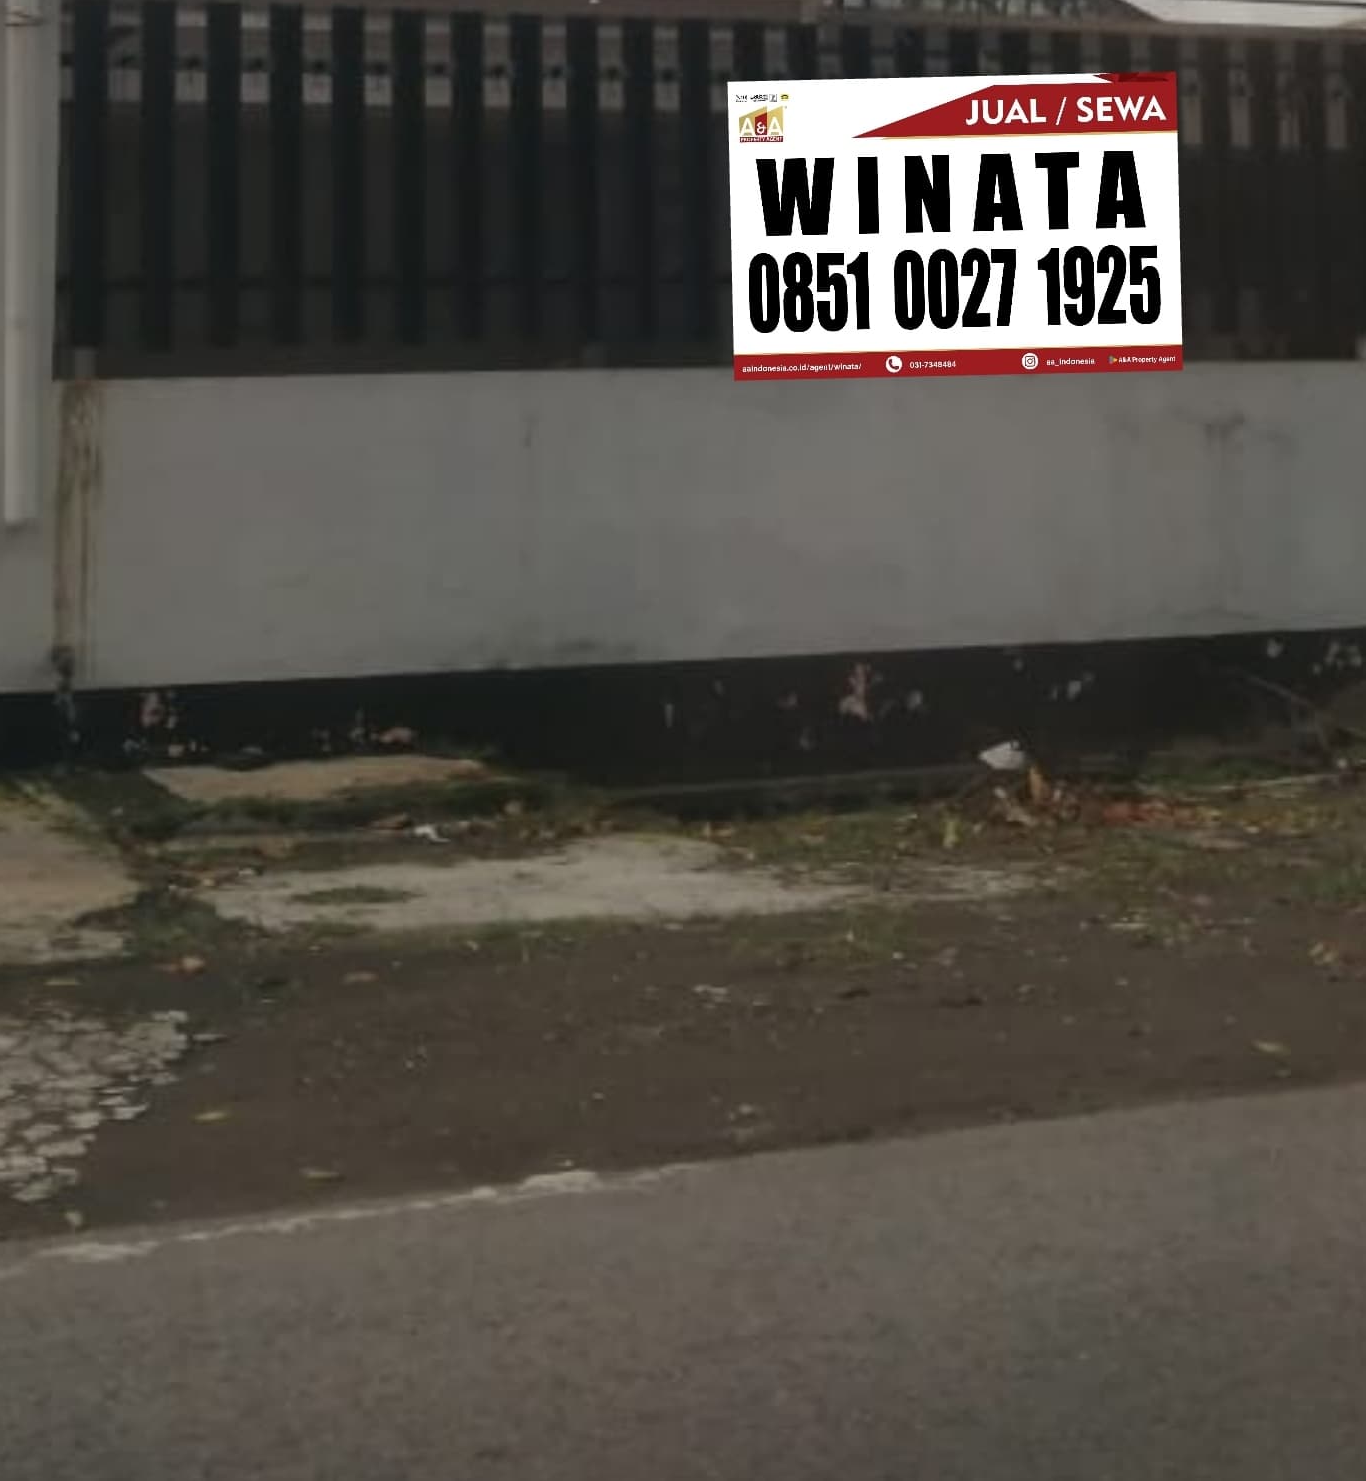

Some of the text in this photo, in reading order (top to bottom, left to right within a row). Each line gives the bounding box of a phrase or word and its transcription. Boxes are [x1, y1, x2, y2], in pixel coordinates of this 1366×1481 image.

[965, 94, 1167, 126] JUAL / SEWA
[755, 150, 1147, 237] WINATA
[748, 244, 1162, 334] 0851 0027 1925
